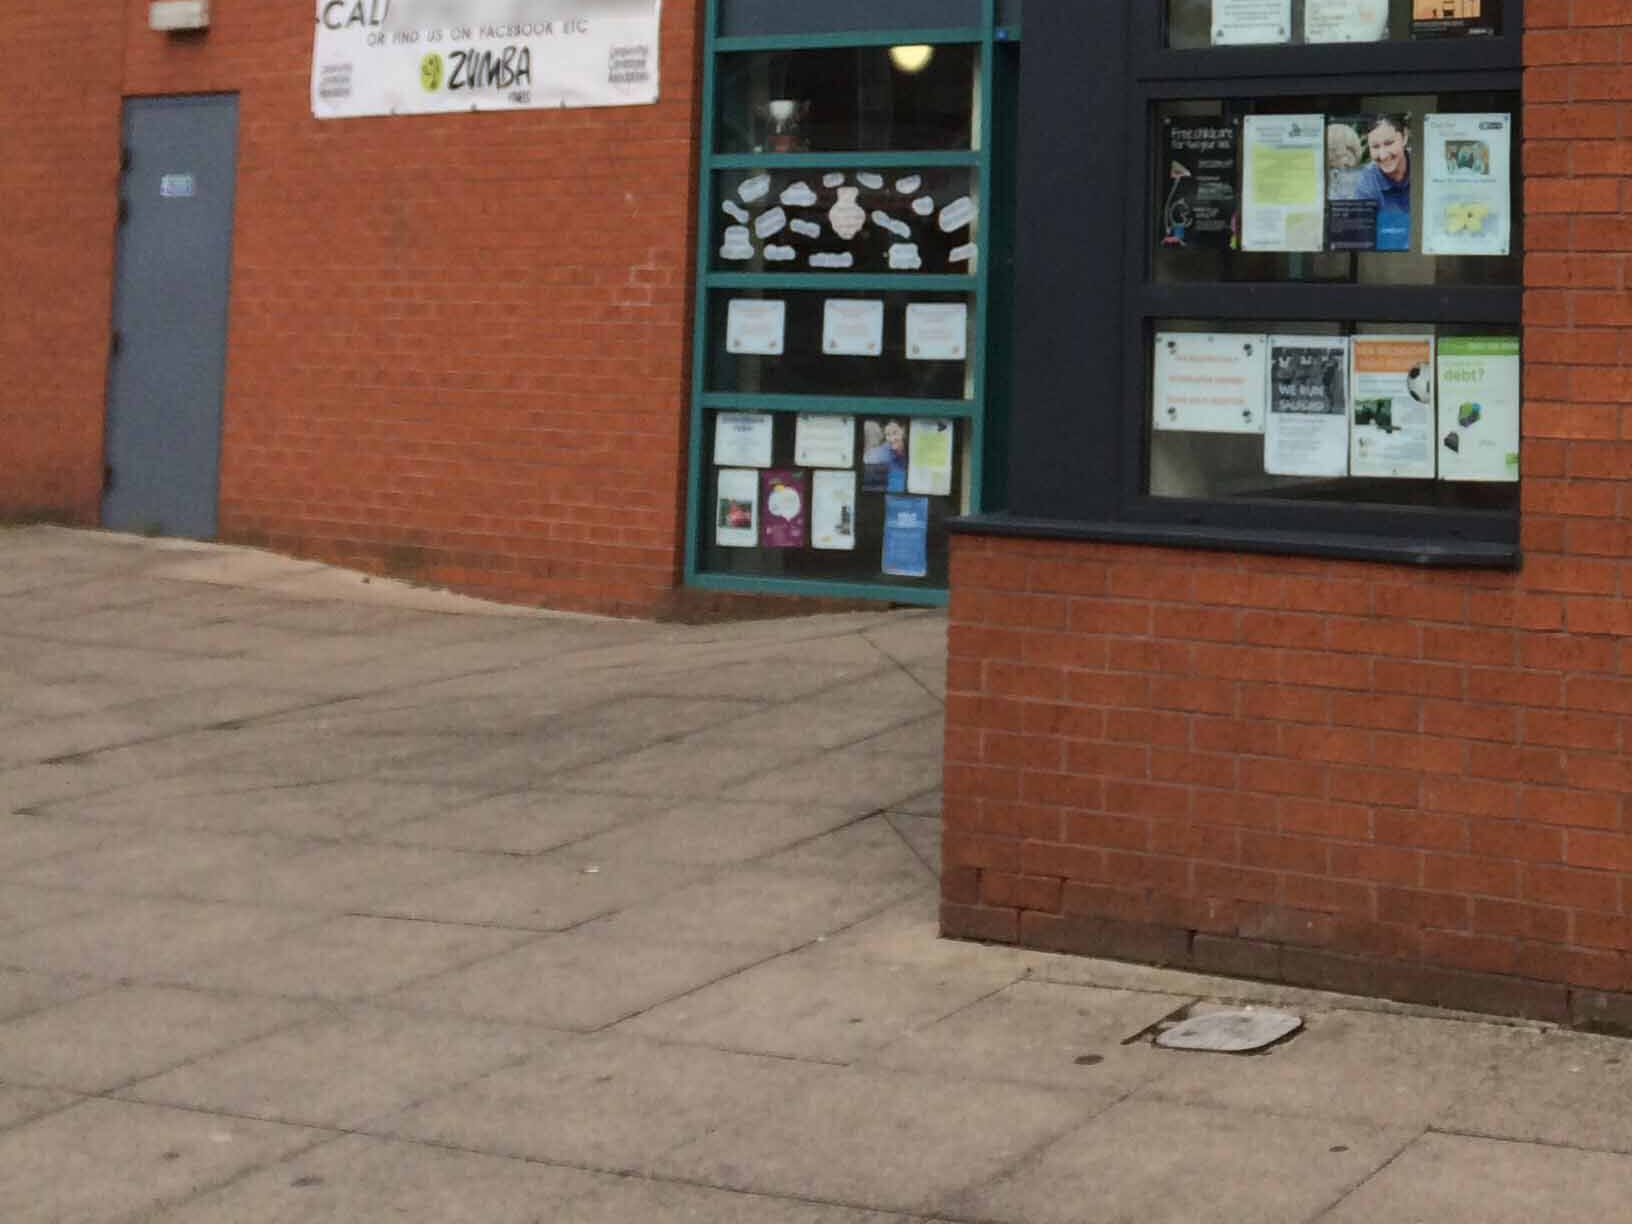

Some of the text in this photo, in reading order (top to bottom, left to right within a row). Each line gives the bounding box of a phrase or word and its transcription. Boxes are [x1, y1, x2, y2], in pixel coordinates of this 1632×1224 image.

[427, 30, 442, 42] US
[451, 29, 471, 42] ON
[448, 46, 531, 90] ZUMBA
